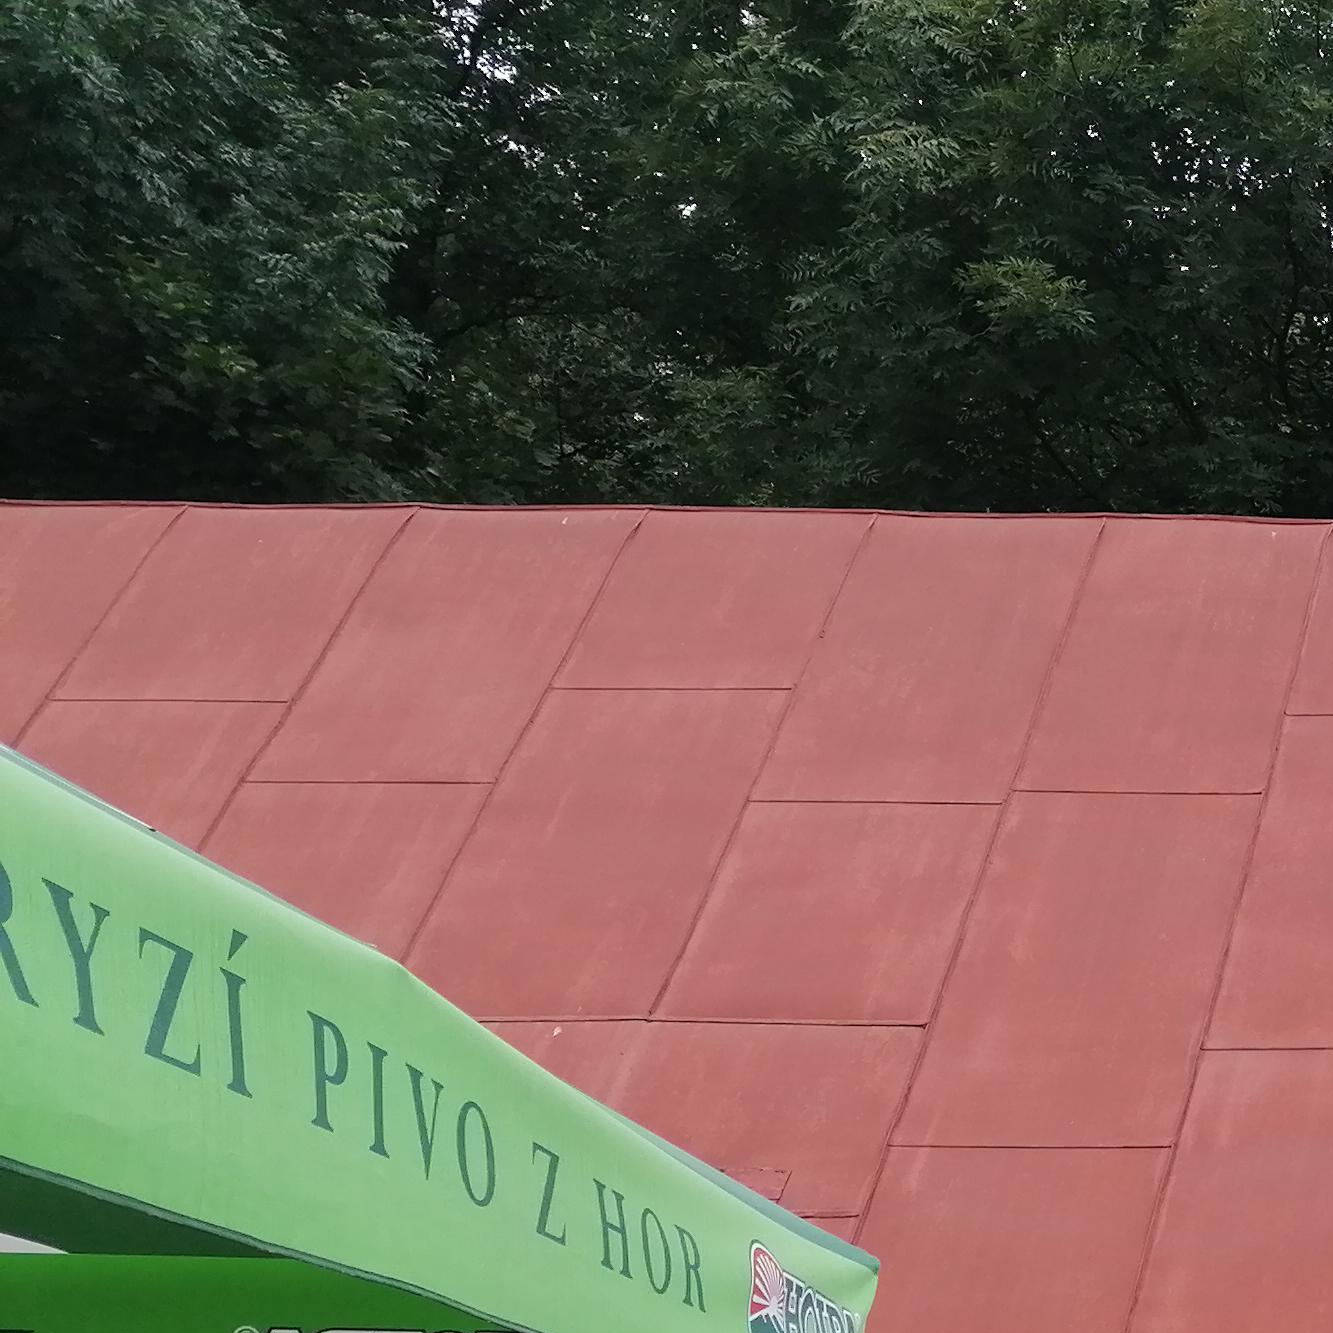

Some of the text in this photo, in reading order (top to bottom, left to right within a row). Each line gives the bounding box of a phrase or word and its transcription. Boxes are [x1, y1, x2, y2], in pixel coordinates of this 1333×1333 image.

[306, 1009, 496, 1208] PIVO
[532, 1141, 567, 1247] Z
[593, 1177, 707, 1314] HOR
